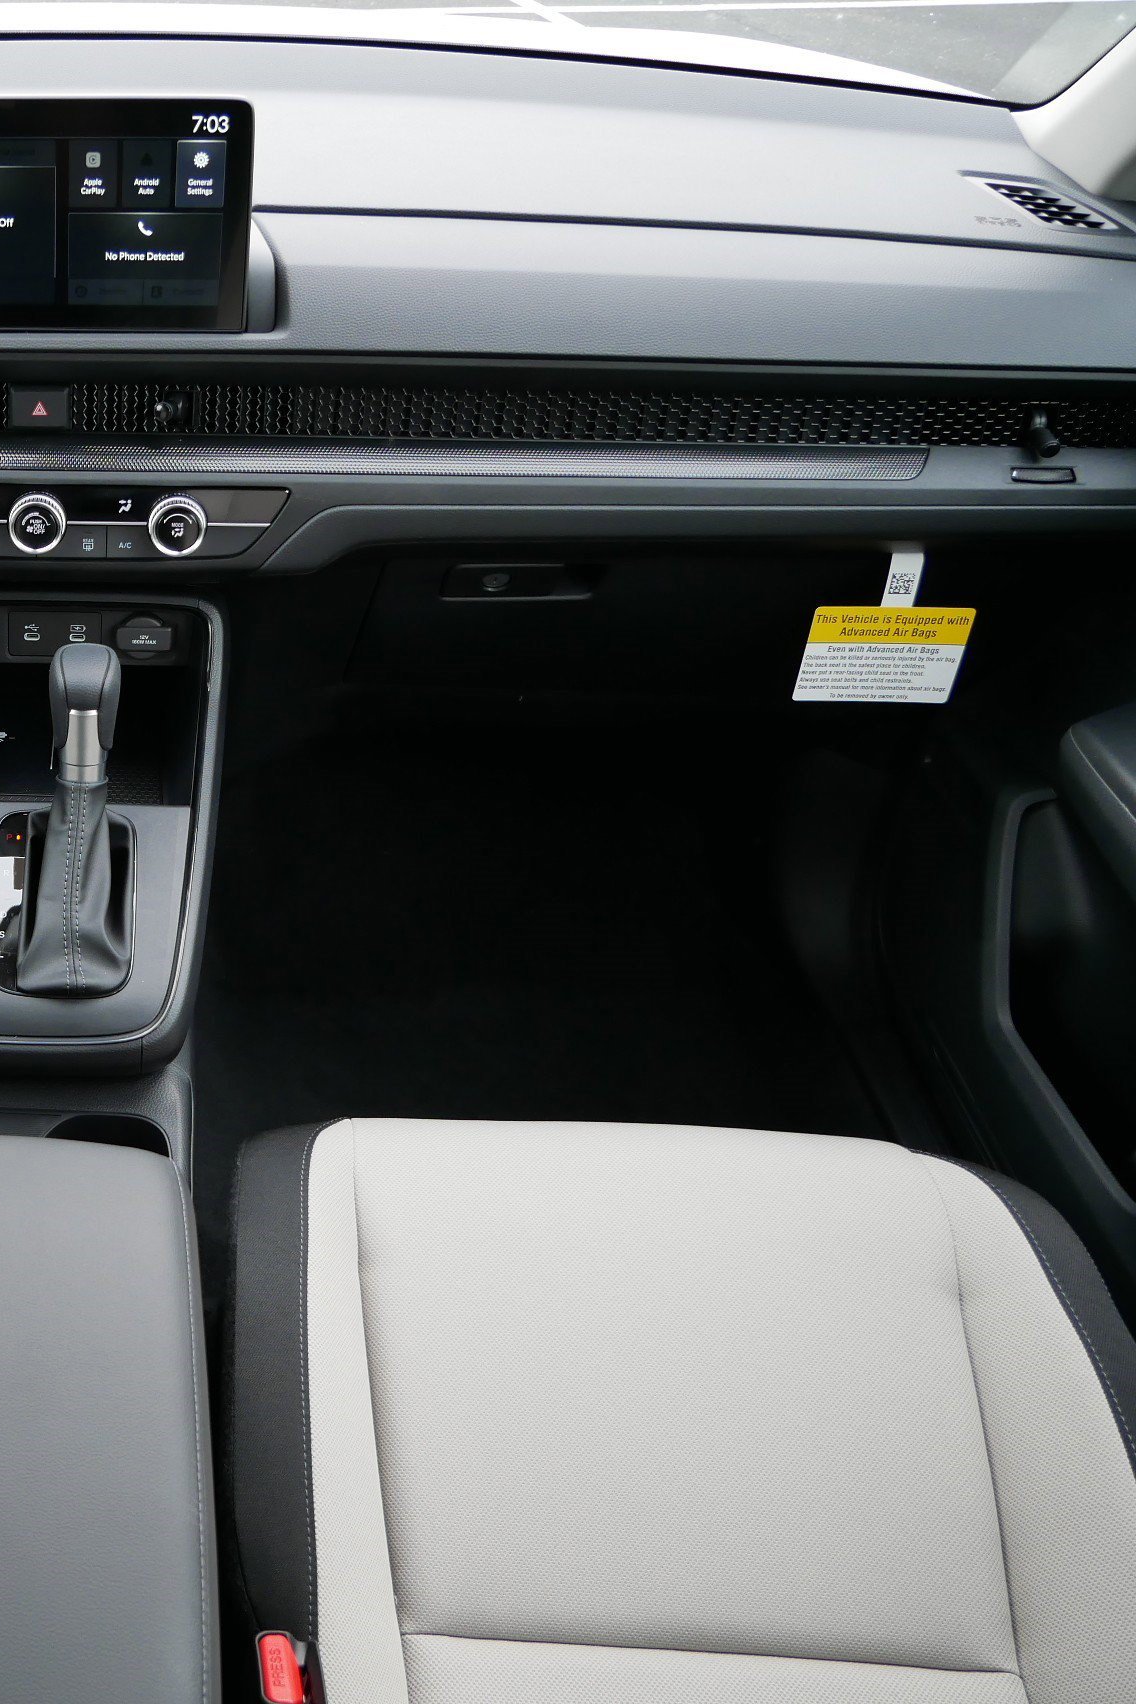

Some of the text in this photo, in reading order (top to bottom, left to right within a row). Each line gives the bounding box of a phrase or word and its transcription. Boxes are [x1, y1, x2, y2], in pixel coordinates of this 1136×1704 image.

[192, 115, 230, 134] 7:03
[83, 178, 102, 187] Apple
[133, 177, 160, 187] Android
[187, 178, 213, 187] General
[80, 187, 106, 196] CarPlay
[138, 187, 155, 195] Auto
[187, 187, 213, 197] Settings
[105, 251, 185, 262] No Phone Detected
[816, 614, 970, 626] This Vehicle is Equipped with
[839, 627, 937, 639] Advanced Air Bags
[827, 645, 846, 653] Even
[848, 645, 865, 653] with
[866, 645, 904, 654] Advanced
[920, 647, 940, 655] Bags
